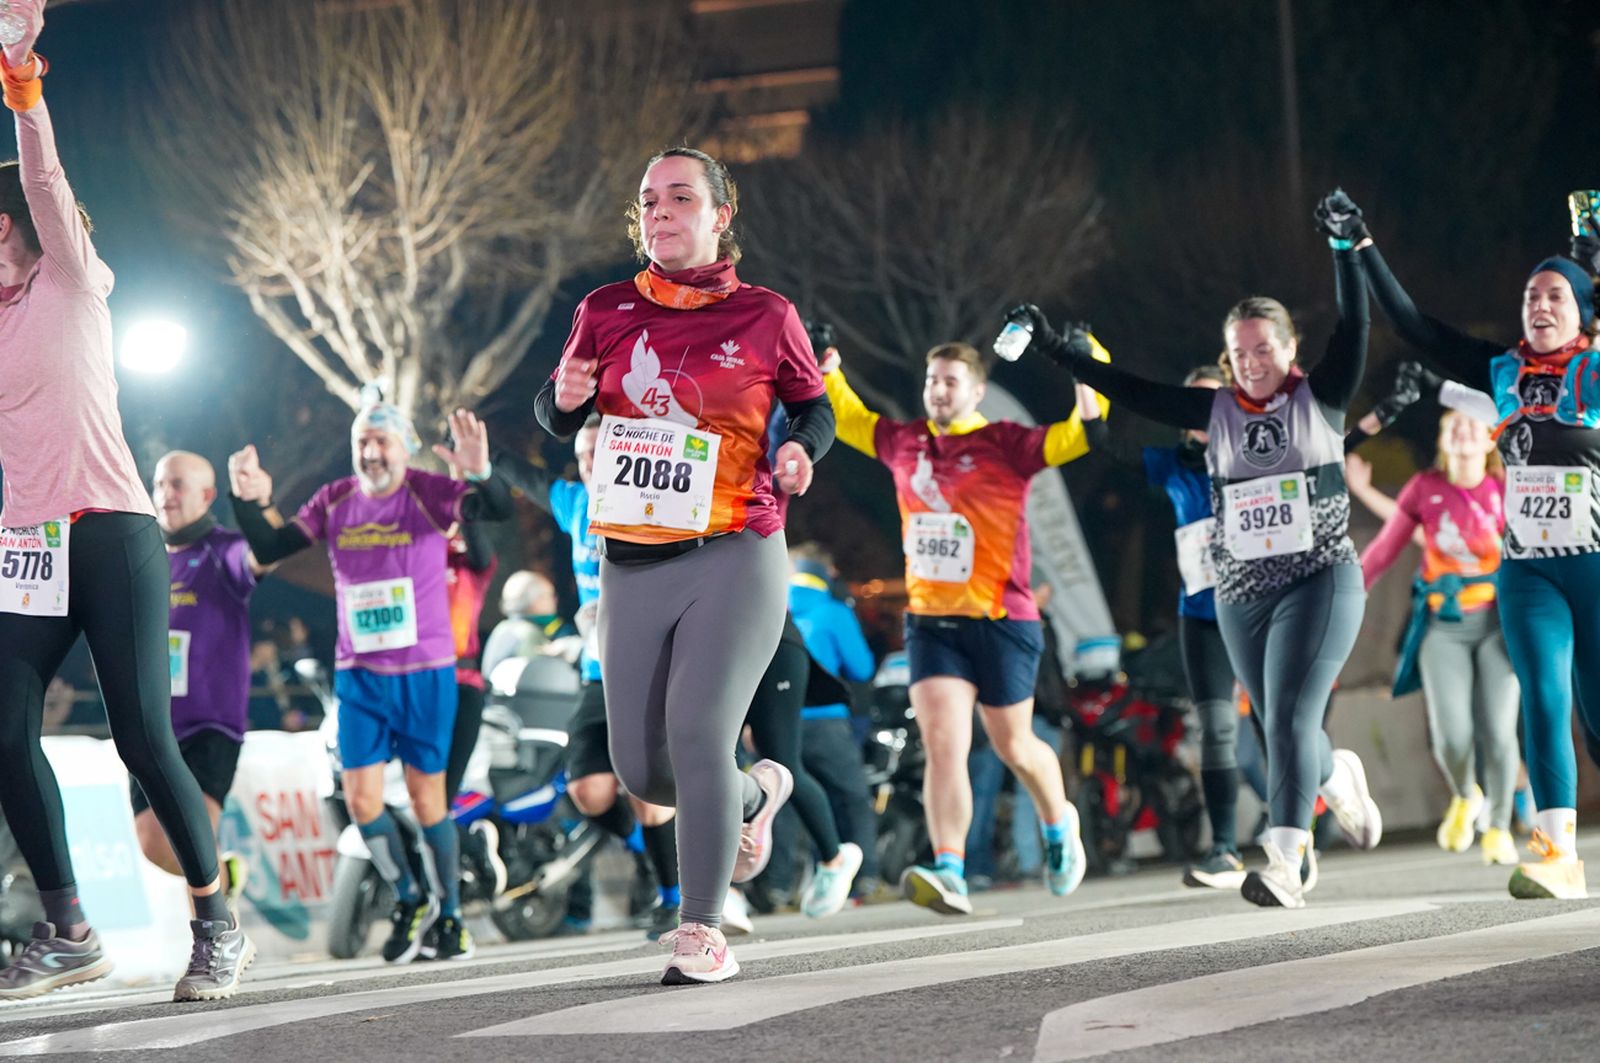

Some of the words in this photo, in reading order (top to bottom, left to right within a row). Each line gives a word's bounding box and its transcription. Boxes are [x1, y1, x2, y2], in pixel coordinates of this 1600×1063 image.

[640, 387, 671, 417] 43
[608, 439, 632, 452] SAN
[633, 440, 673, 458] ANTÓN
[625, 430, 659, 442] NOCHE
[660, 433, 675, 444] DE
[614, 455, 692, 493] 2088
[1239, 503, 1293, 532] 3928
[1520, 496, 1571, 519] 4223
[916, 538, 960, 558] 5962
[1, 549, 53, 581] 5778
[256, 791, 320, 842] SAN
